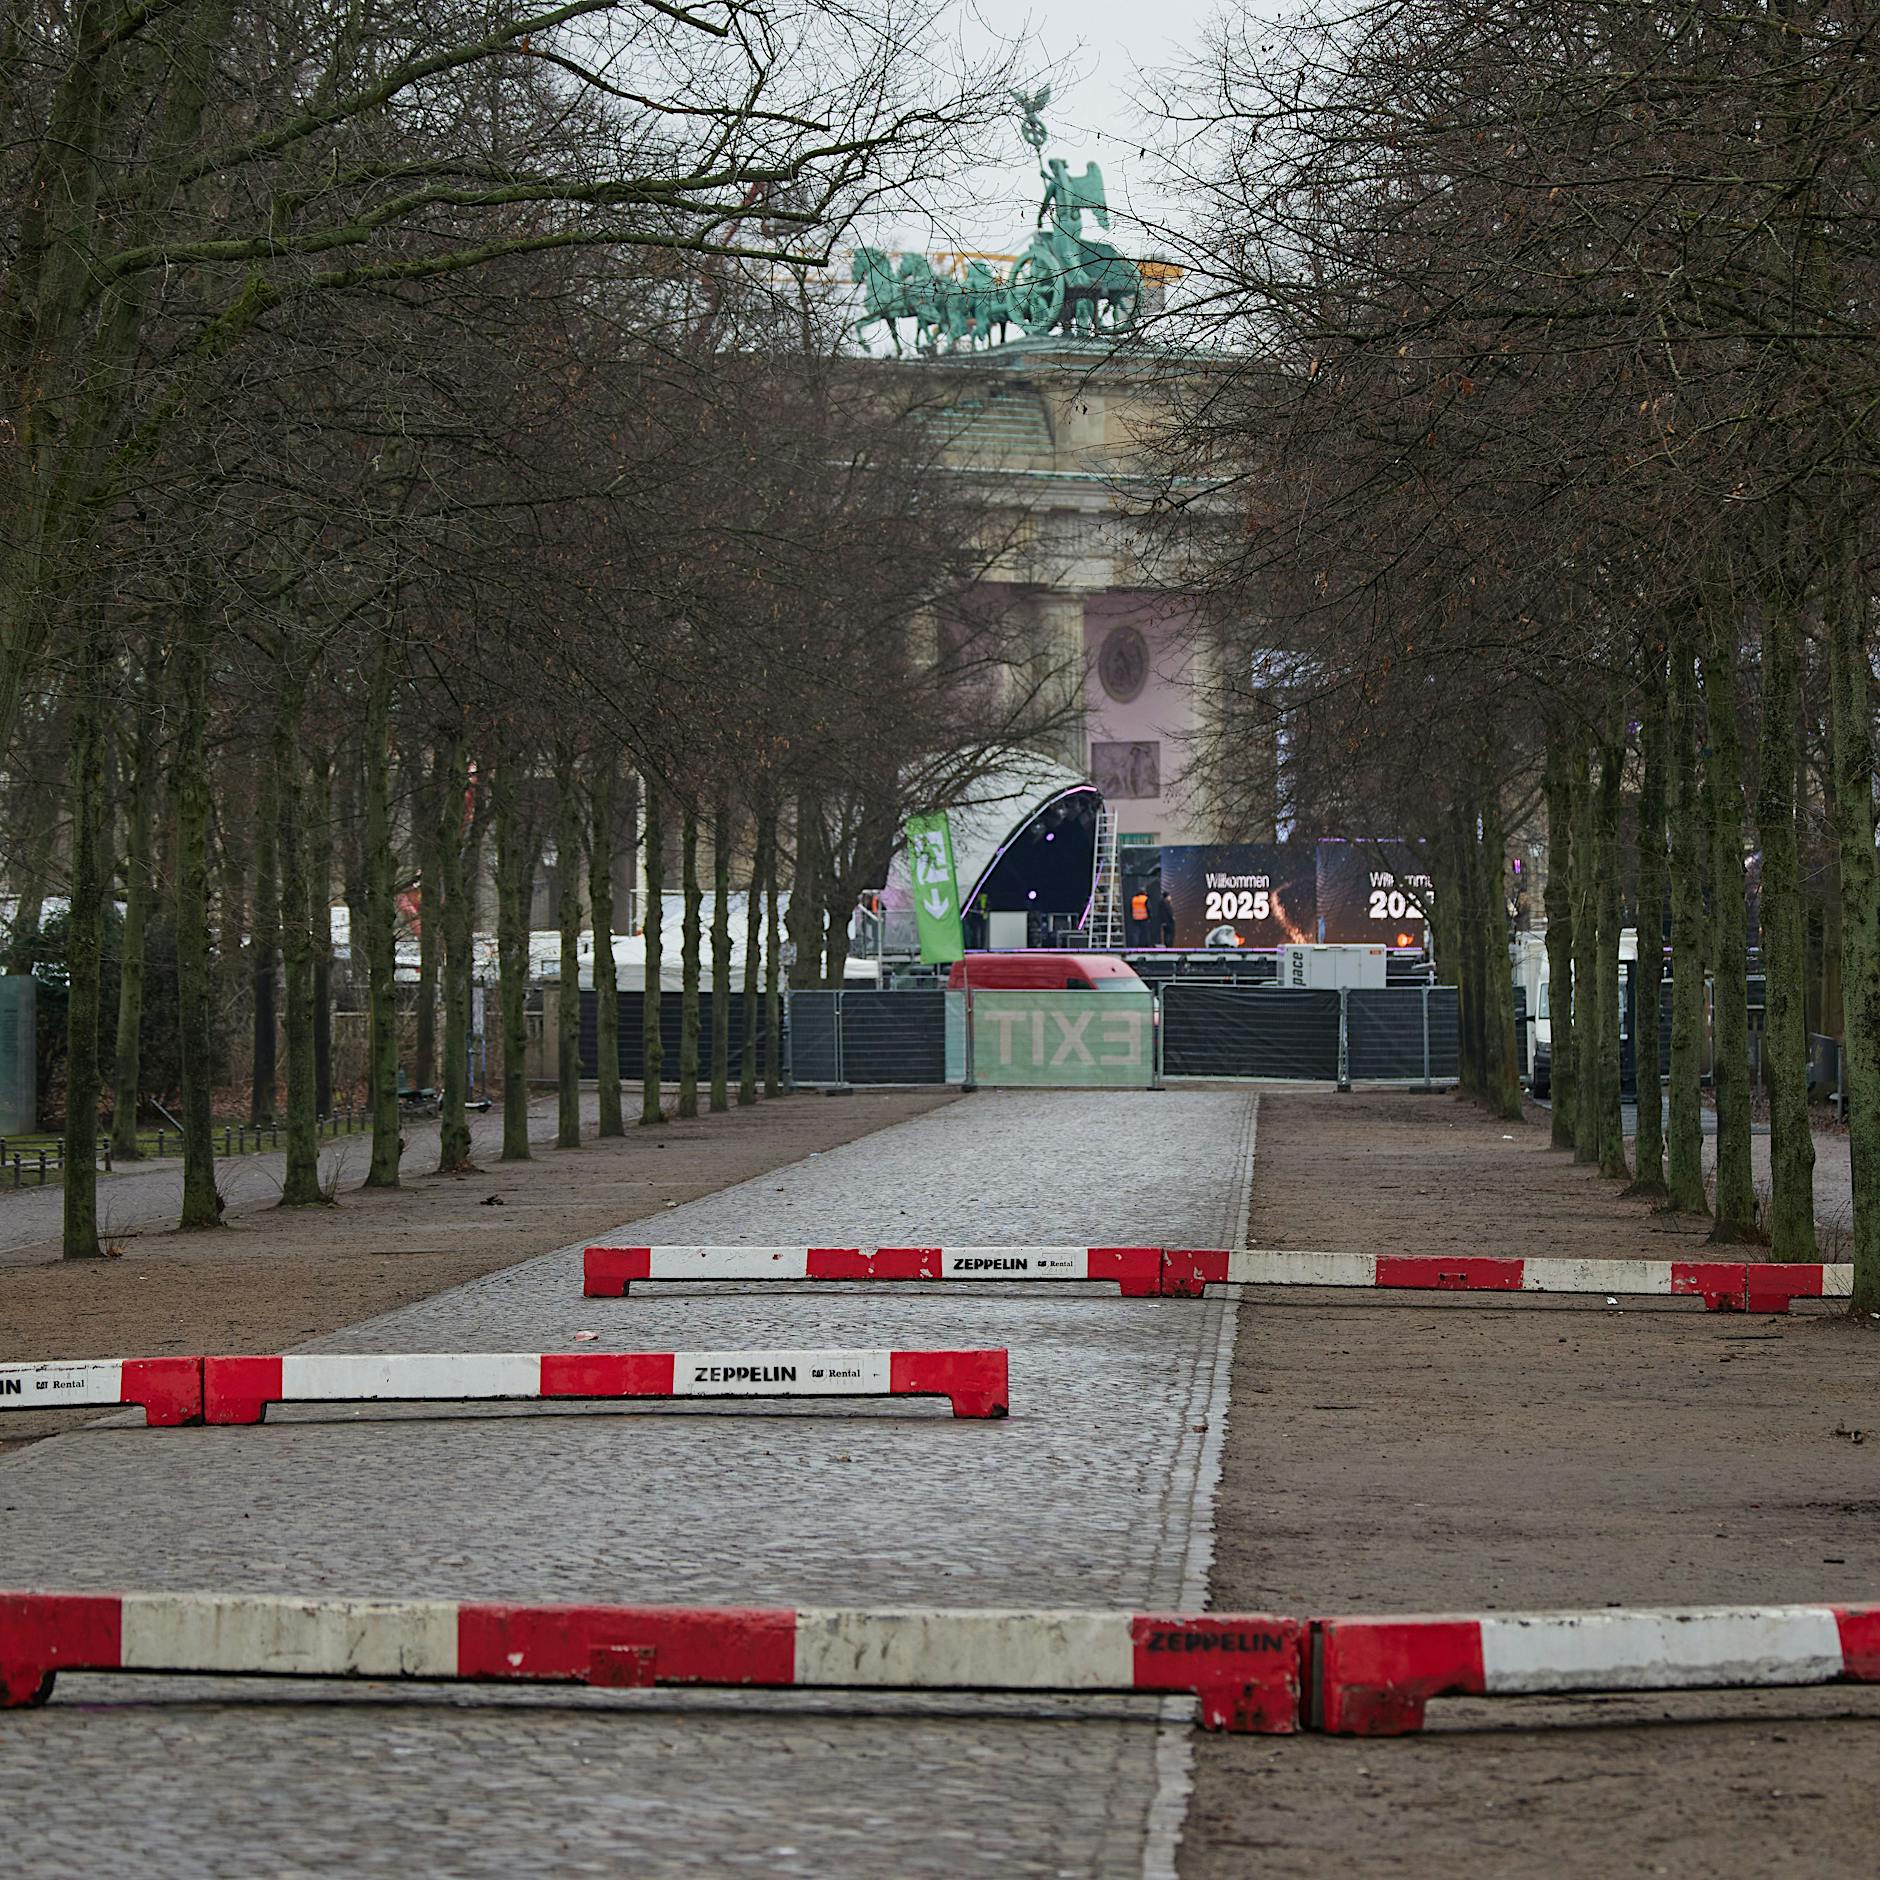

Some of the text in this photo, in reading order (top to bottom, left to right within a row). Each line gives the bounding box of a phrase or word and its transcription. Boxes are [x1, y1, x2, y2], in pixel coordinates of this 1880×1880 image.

[1205, 873, 1270, 889] Willkommen
[1205, 891, 1270, 920] 2025
[953, 1258, 1028, 1269] ZEPPELIN
[694, 1366, 797, 1383] ZEPPELIN
[829, 1368, 861, 1378] Rental
[36, 1381, 48, 1390] CAT
[53, 1379, 85, 1389] Rental
[1147, 1632, 1283, 1652] ZEPPELIN
